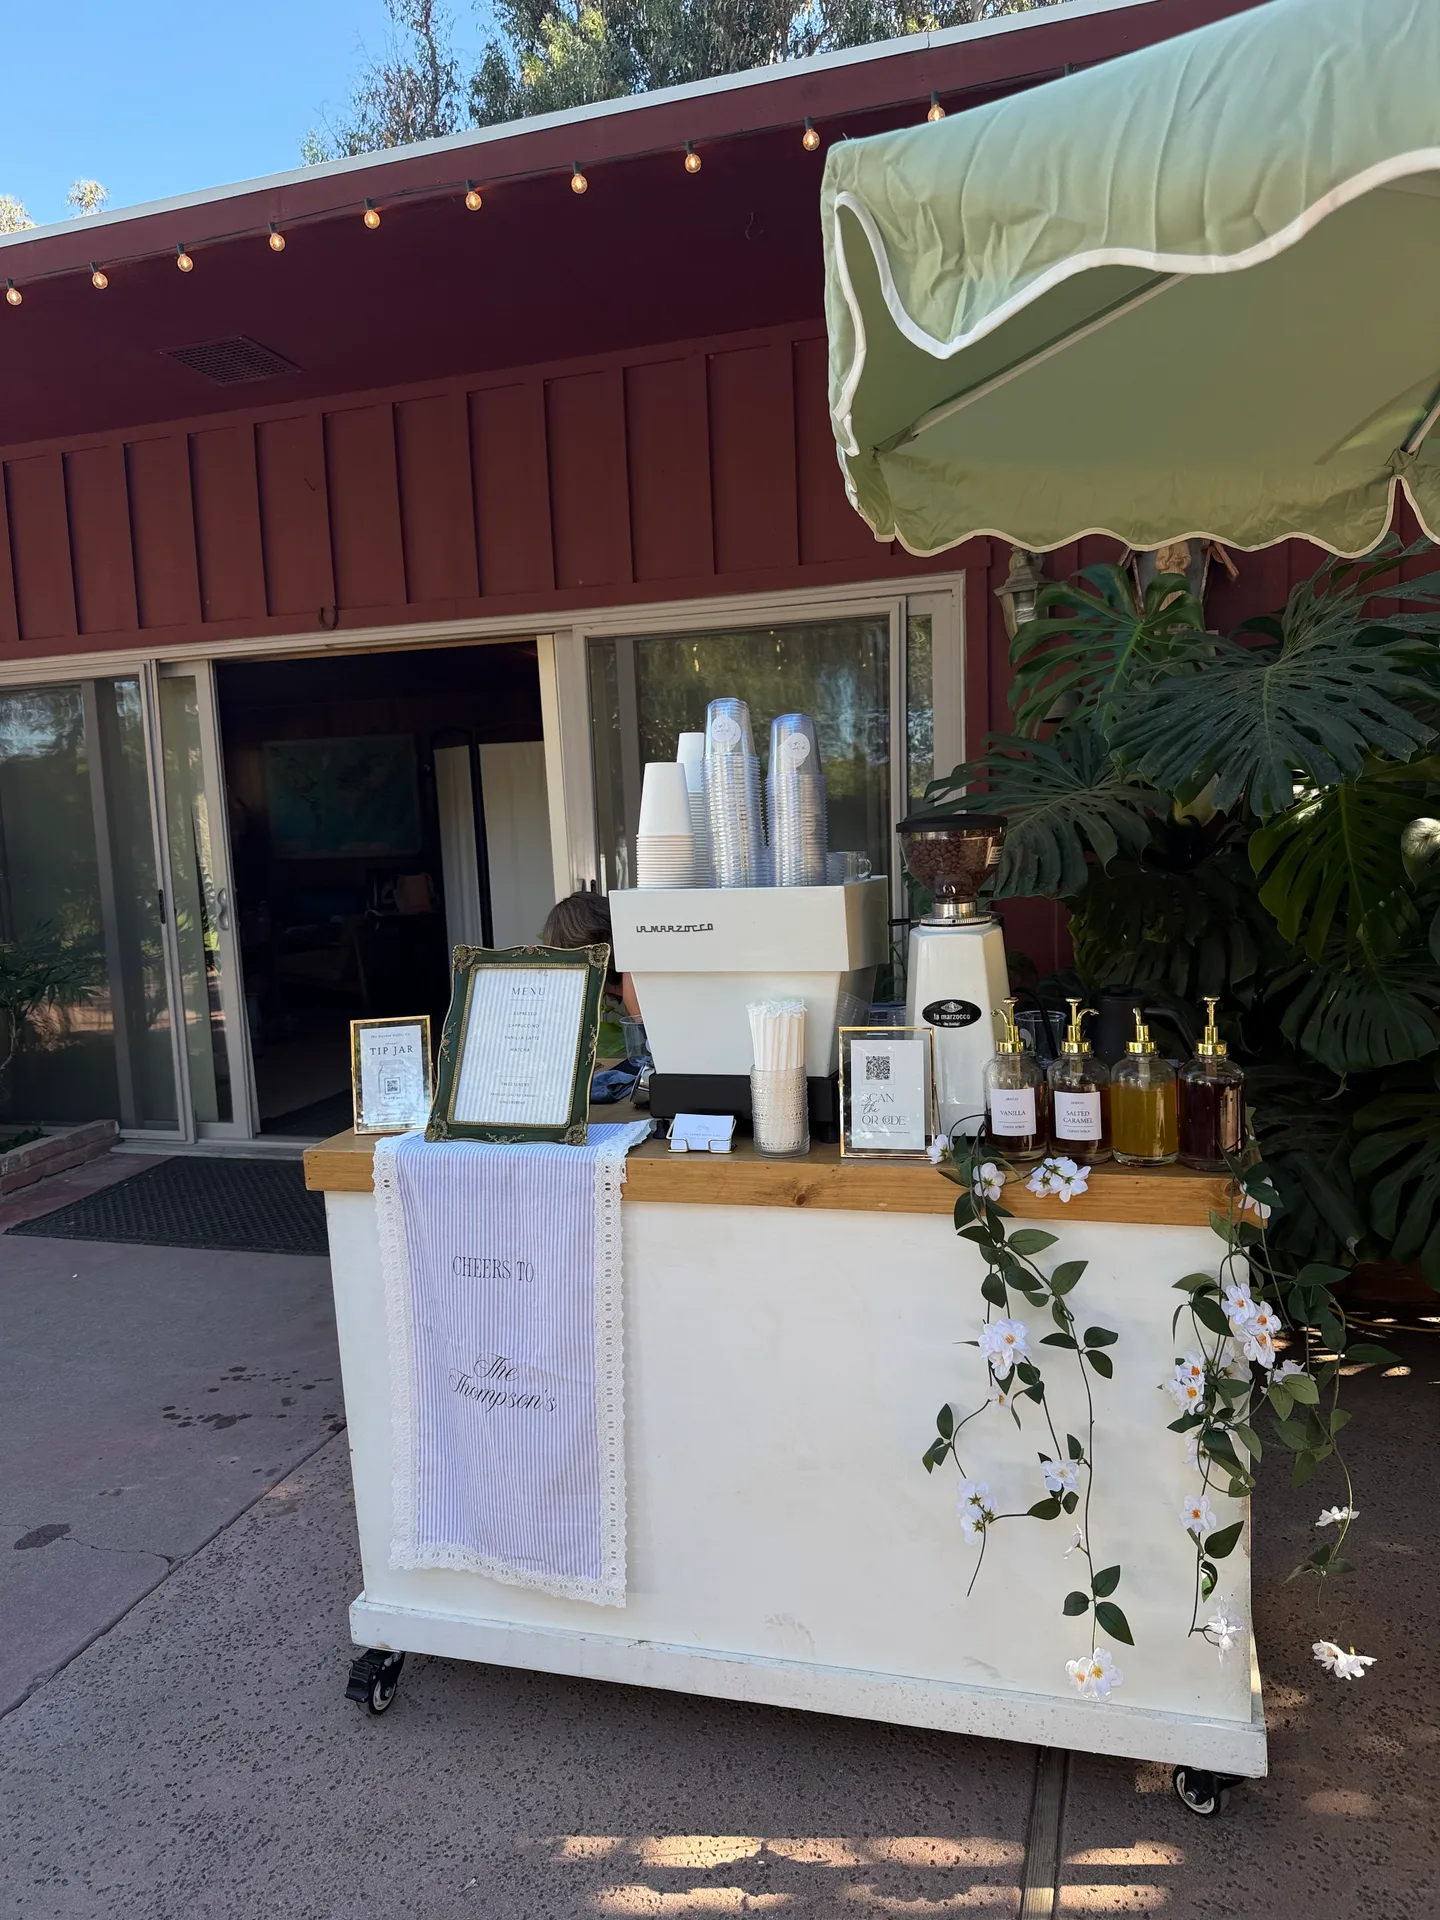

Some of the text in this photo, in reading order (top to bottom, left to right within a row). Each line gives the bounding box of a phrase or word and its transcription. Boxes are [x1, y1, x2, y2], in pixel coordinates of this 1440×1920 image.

[636, 923, 714, 933] LA MARZOCCO
[511, 987, 546, 996] MENU
[369, 1044, 414, 1057] TIP JAR
[861, 1092, 895, 1103] SCAN
[861, 1100, 881, 1114] the
[861, 1114, 906, 1126] QR CODE
[452, 1255, 535, 1283] CHEERS TO
[473, 1351, 520, 1382] The
[448, 1367, 558, 1413] Thompson's
